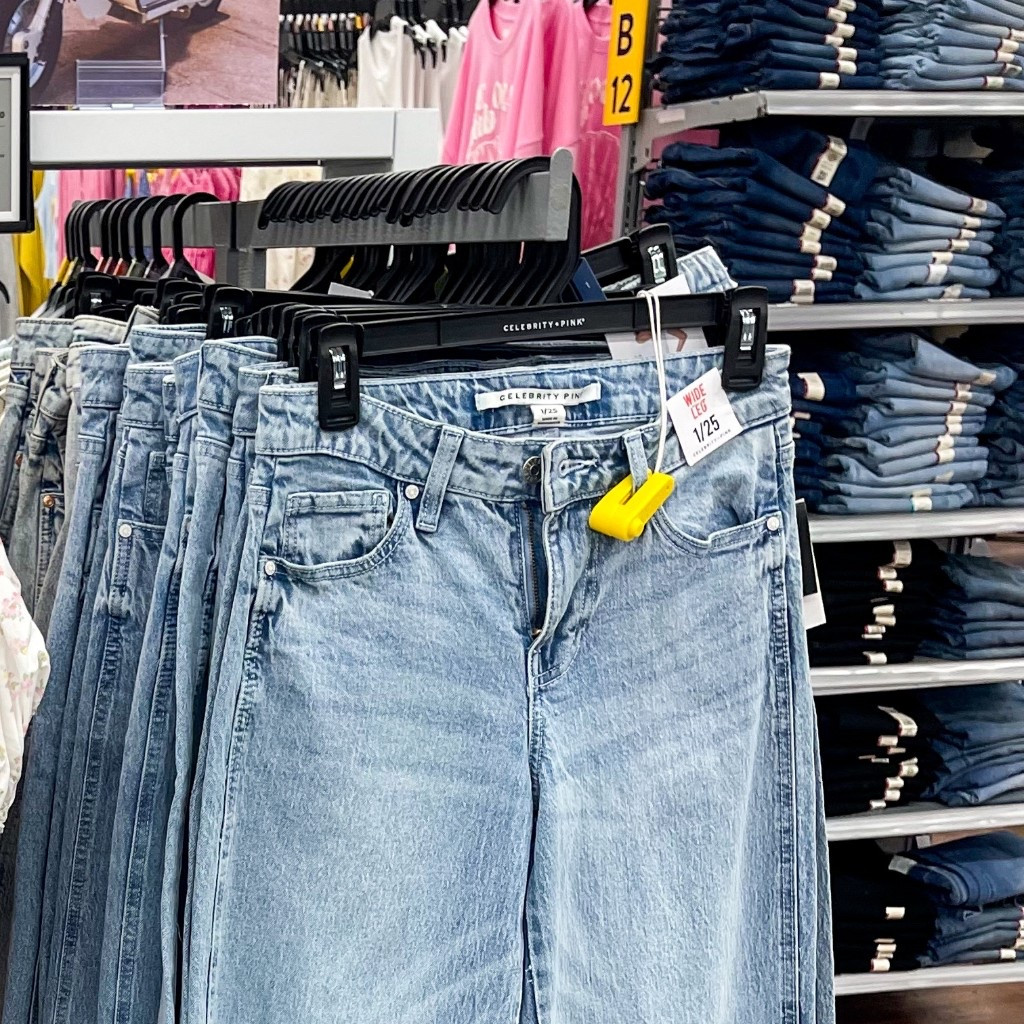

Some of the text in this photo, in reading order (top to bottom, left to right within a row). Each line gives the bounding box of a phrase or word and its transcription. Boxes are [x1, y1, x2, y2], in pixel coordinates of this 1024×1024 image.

[617, 13, 634, 57] B
[611, 74, 633, 114] 12
[503, 318, 583, 332] CELEBRITY PINK
[499, 392, 559, 401] CELEBRITY
[683, 383, 706, 407] WIDE
[690, 398, 708, 420] LEG
[693, 414, 720, 443] 1/25
